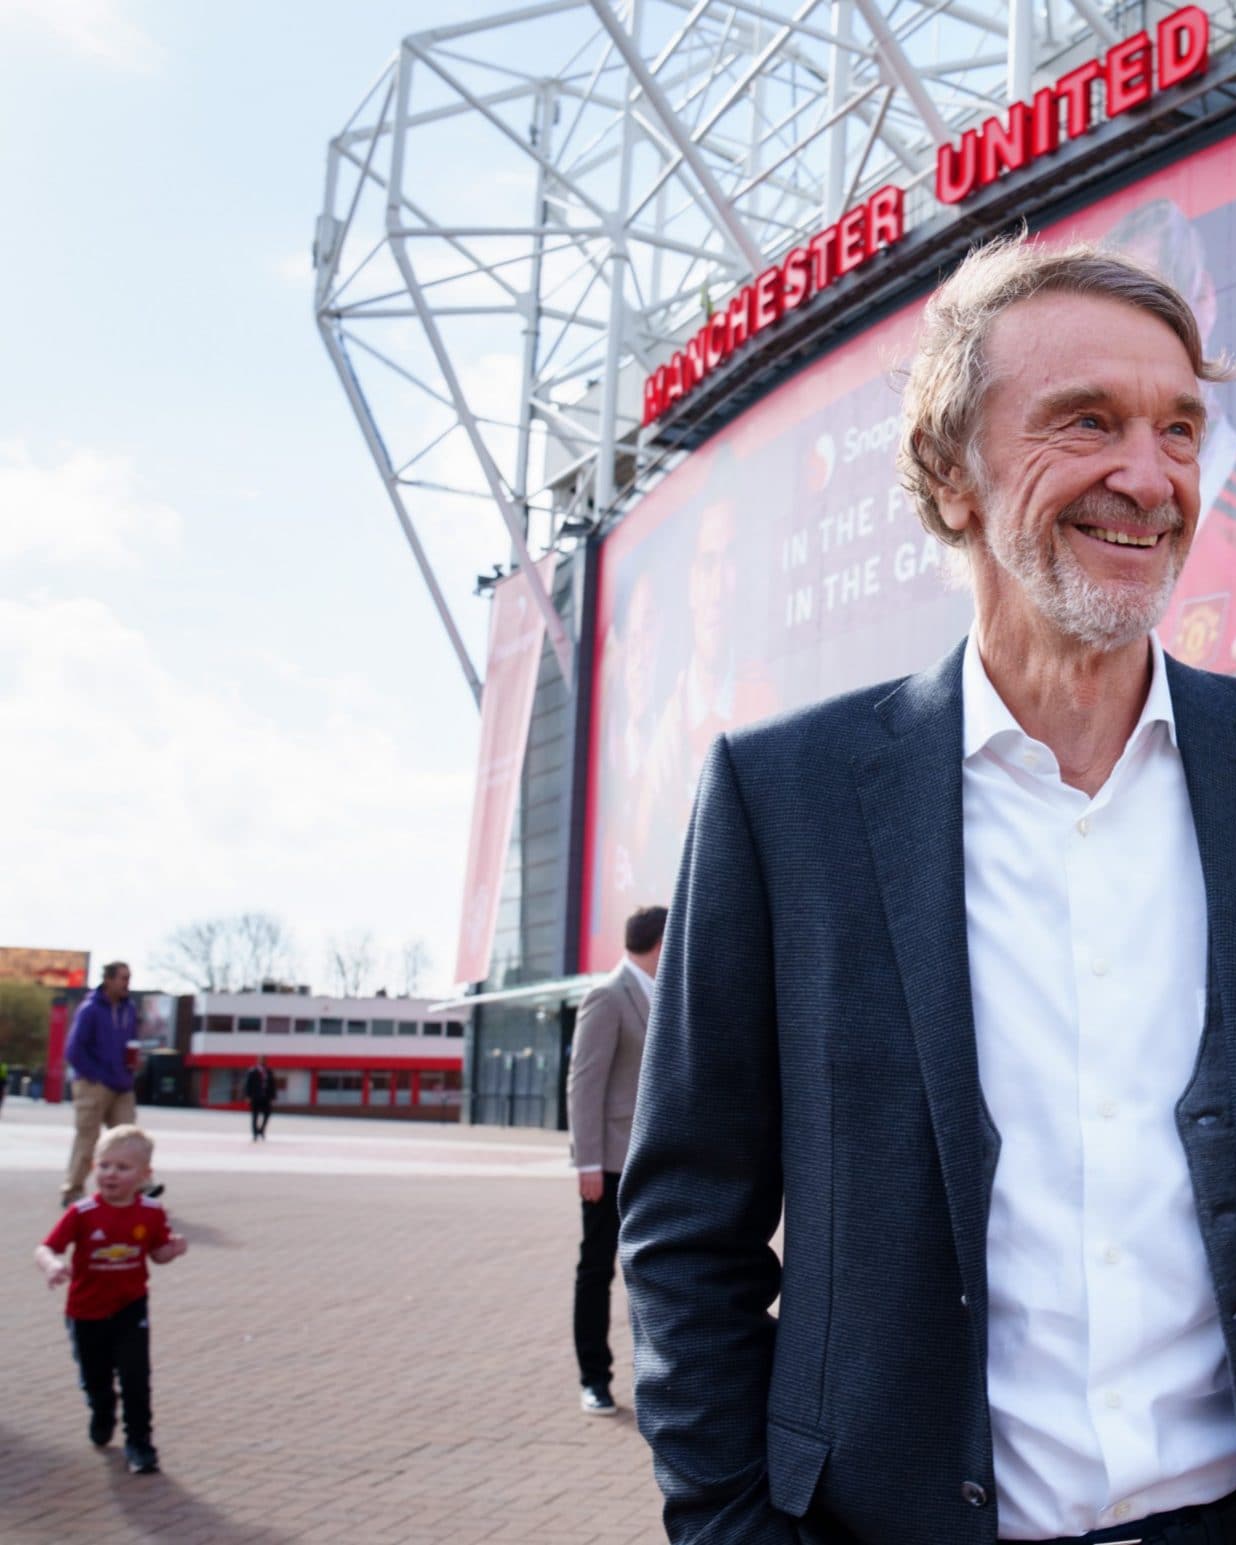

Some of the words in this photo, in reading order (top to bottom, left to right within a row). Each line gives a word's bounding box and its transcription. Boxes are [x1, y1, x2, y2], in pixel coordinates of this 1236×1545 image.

[641, 184, 905, 428] MANCHESTER
[934, 4, 1210, 205] UNITED
[844, 416, 903, 462] Snap
[782, 529, 808, 571] IN
[818, 496, 876, 553] THE
[785, 587, 812, 627] IN
[823, 555, 882, 612] THE
[893, 535, 942, 583] GA
